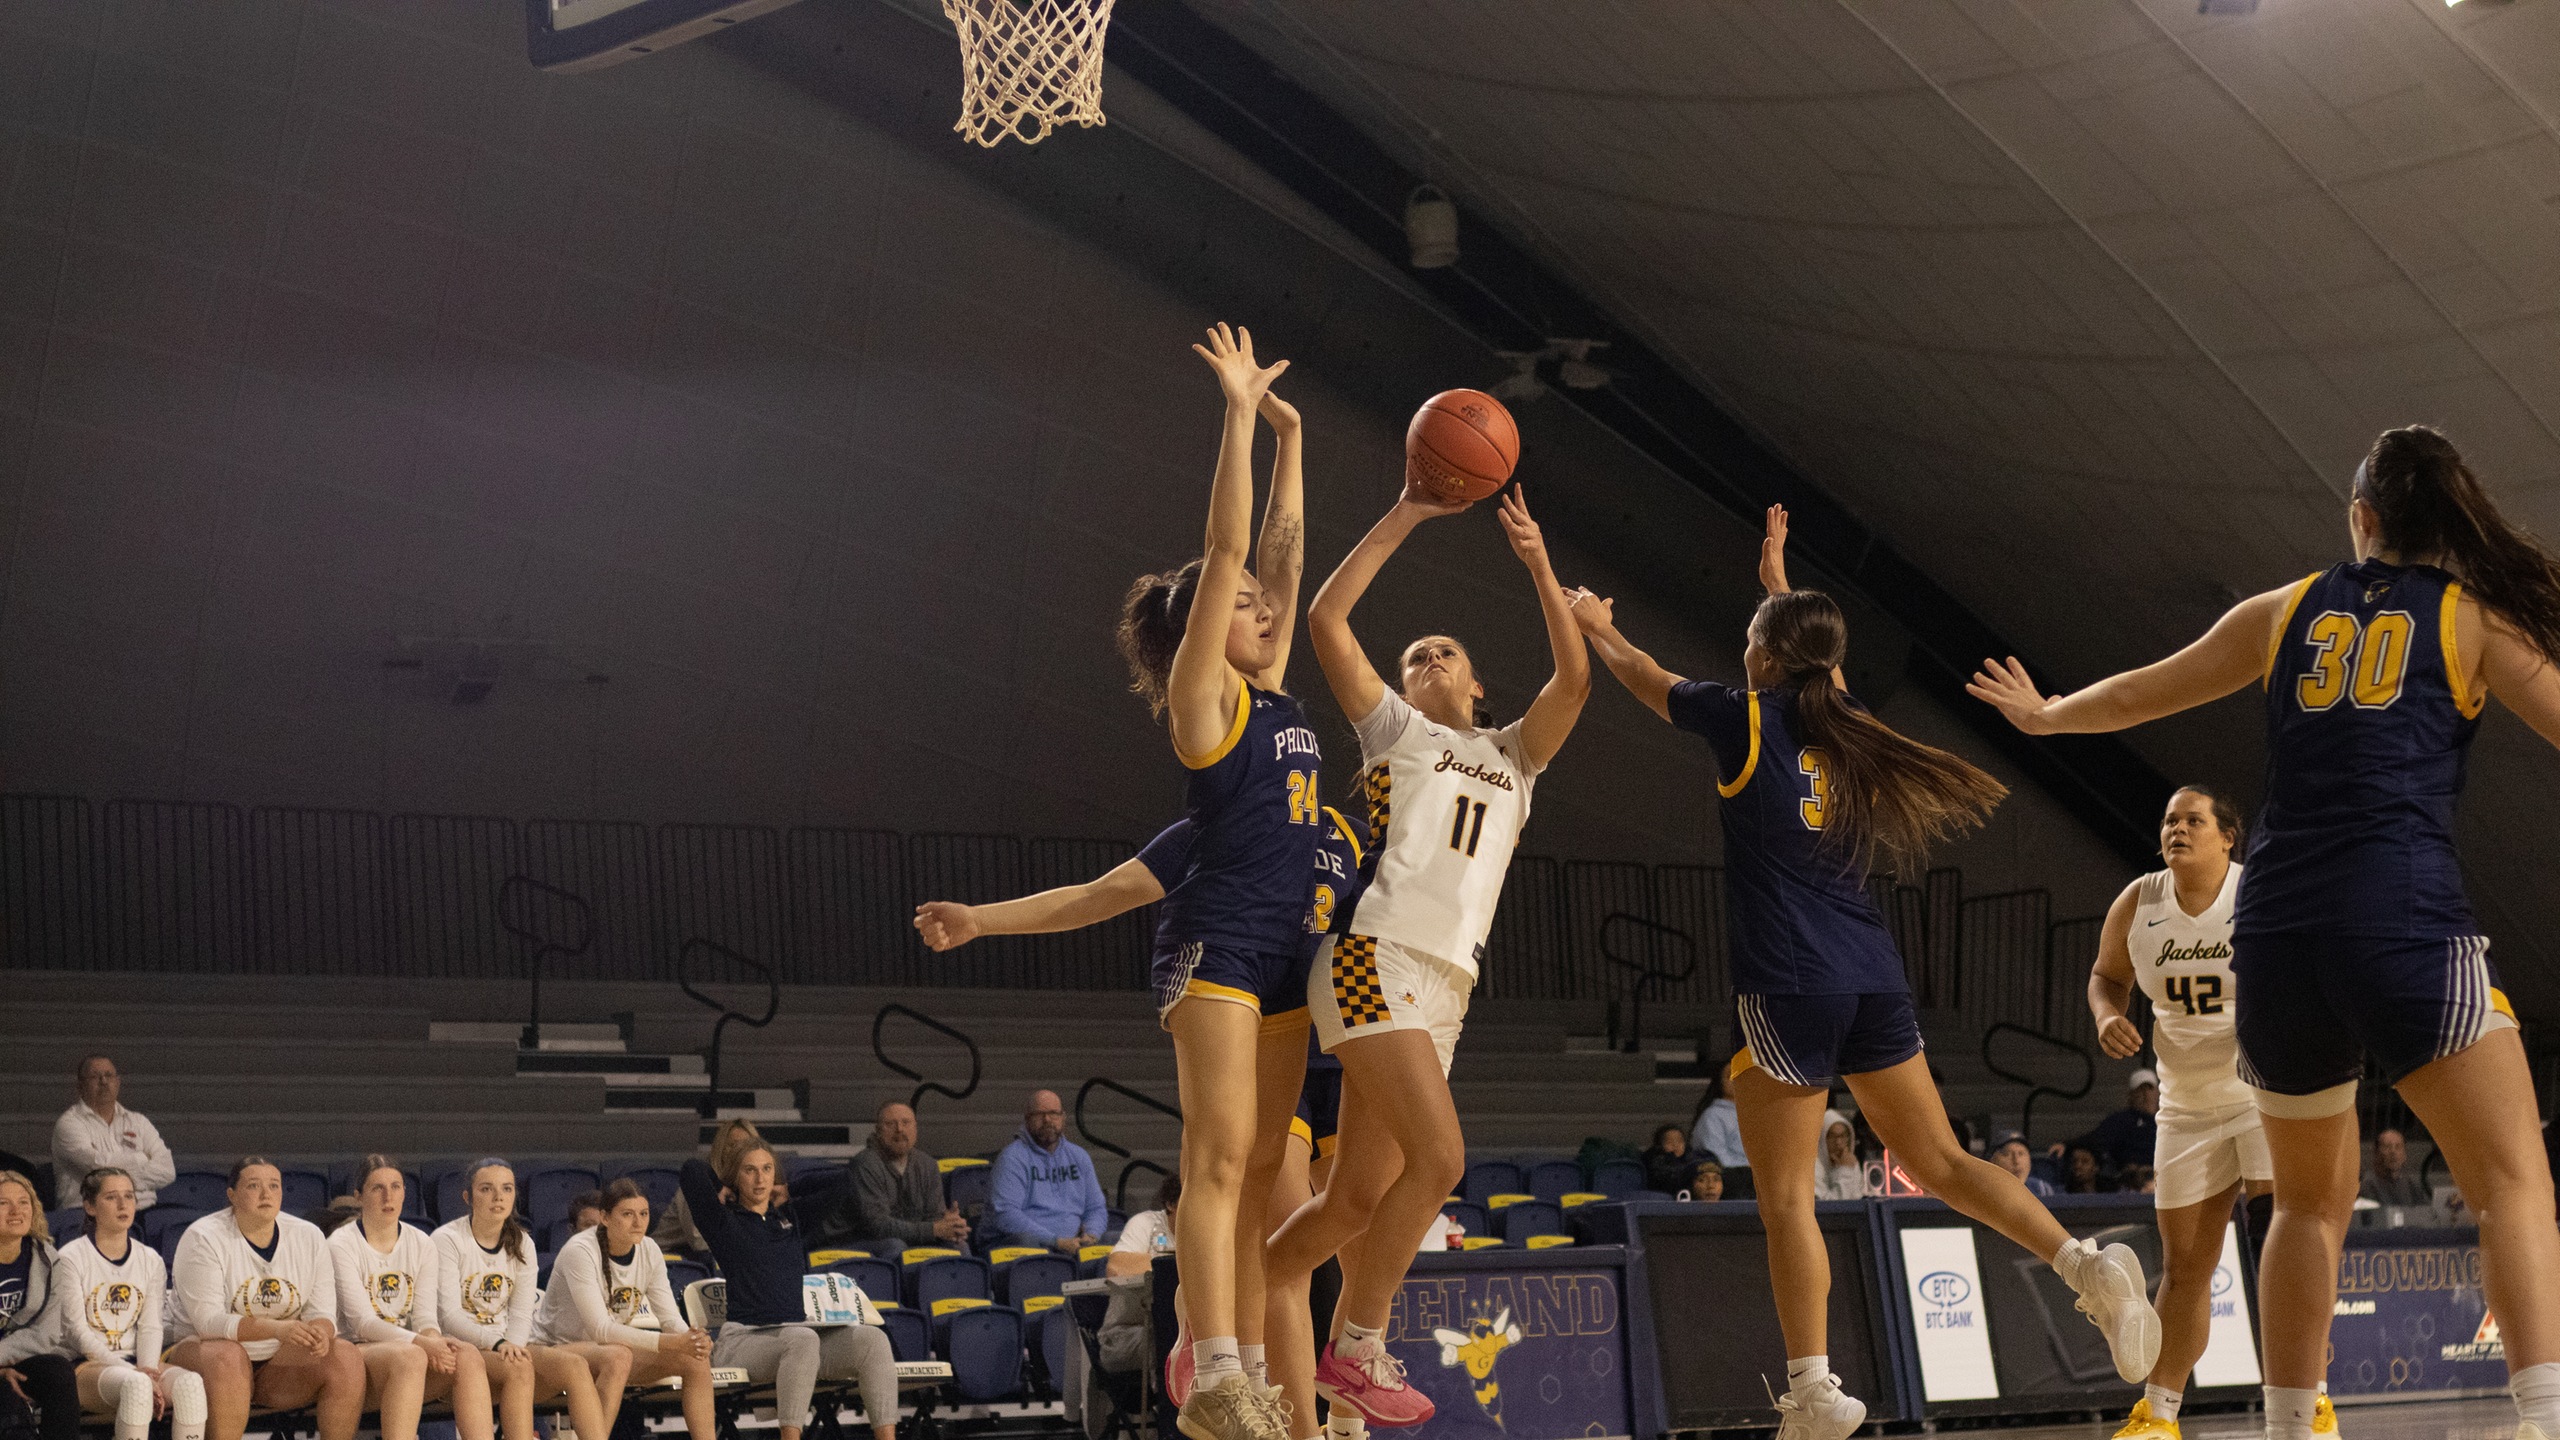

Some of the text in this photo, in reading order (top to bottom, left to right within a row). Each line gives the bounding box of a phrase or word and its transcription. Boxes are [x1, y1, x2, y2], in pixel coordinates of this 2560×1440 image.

[2297, 610, 2416, 712] 30
[1434, 749, 1514, 792] Jackets
[1798, 746, 1838, 831] 3
[1286, 769, 1319, 825] 24
[1449, 793, 1488, 860] 11
[2155, 939, 2232, 967] Jackets
[2165, 975, 2224, 1016] 42
[1933, 1278, 1957, 1298] BTC
[1926, 1311, 1974, 1329] BTC BANK
[1477, 1355, 1491, 1370] G
